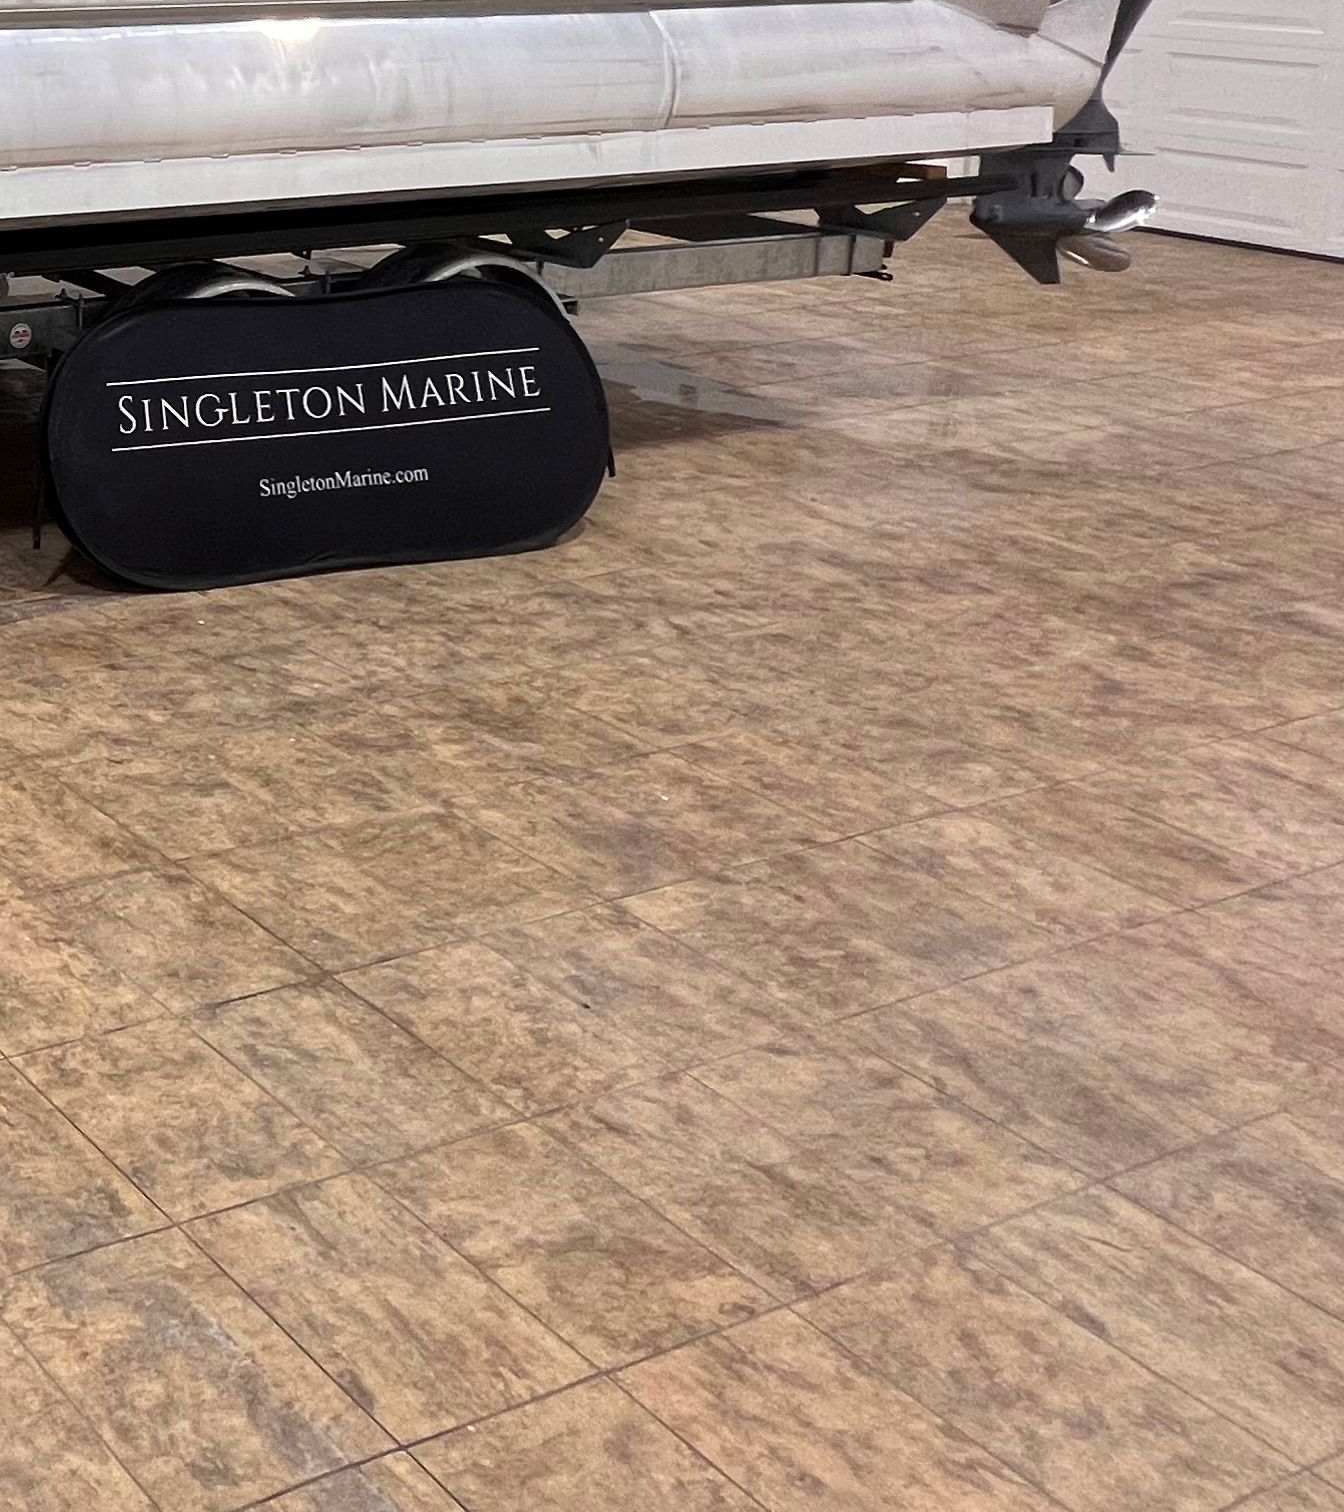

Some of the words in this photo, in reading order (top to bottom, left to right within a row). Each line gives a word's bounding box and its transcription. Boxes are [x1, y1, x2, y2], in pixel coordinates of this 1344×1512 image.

[117, 382, 366, 436] SINGLETON
[380, 365, 542, 414] MARINE
[258, 466, 430, 500] SingletonMarine.com
